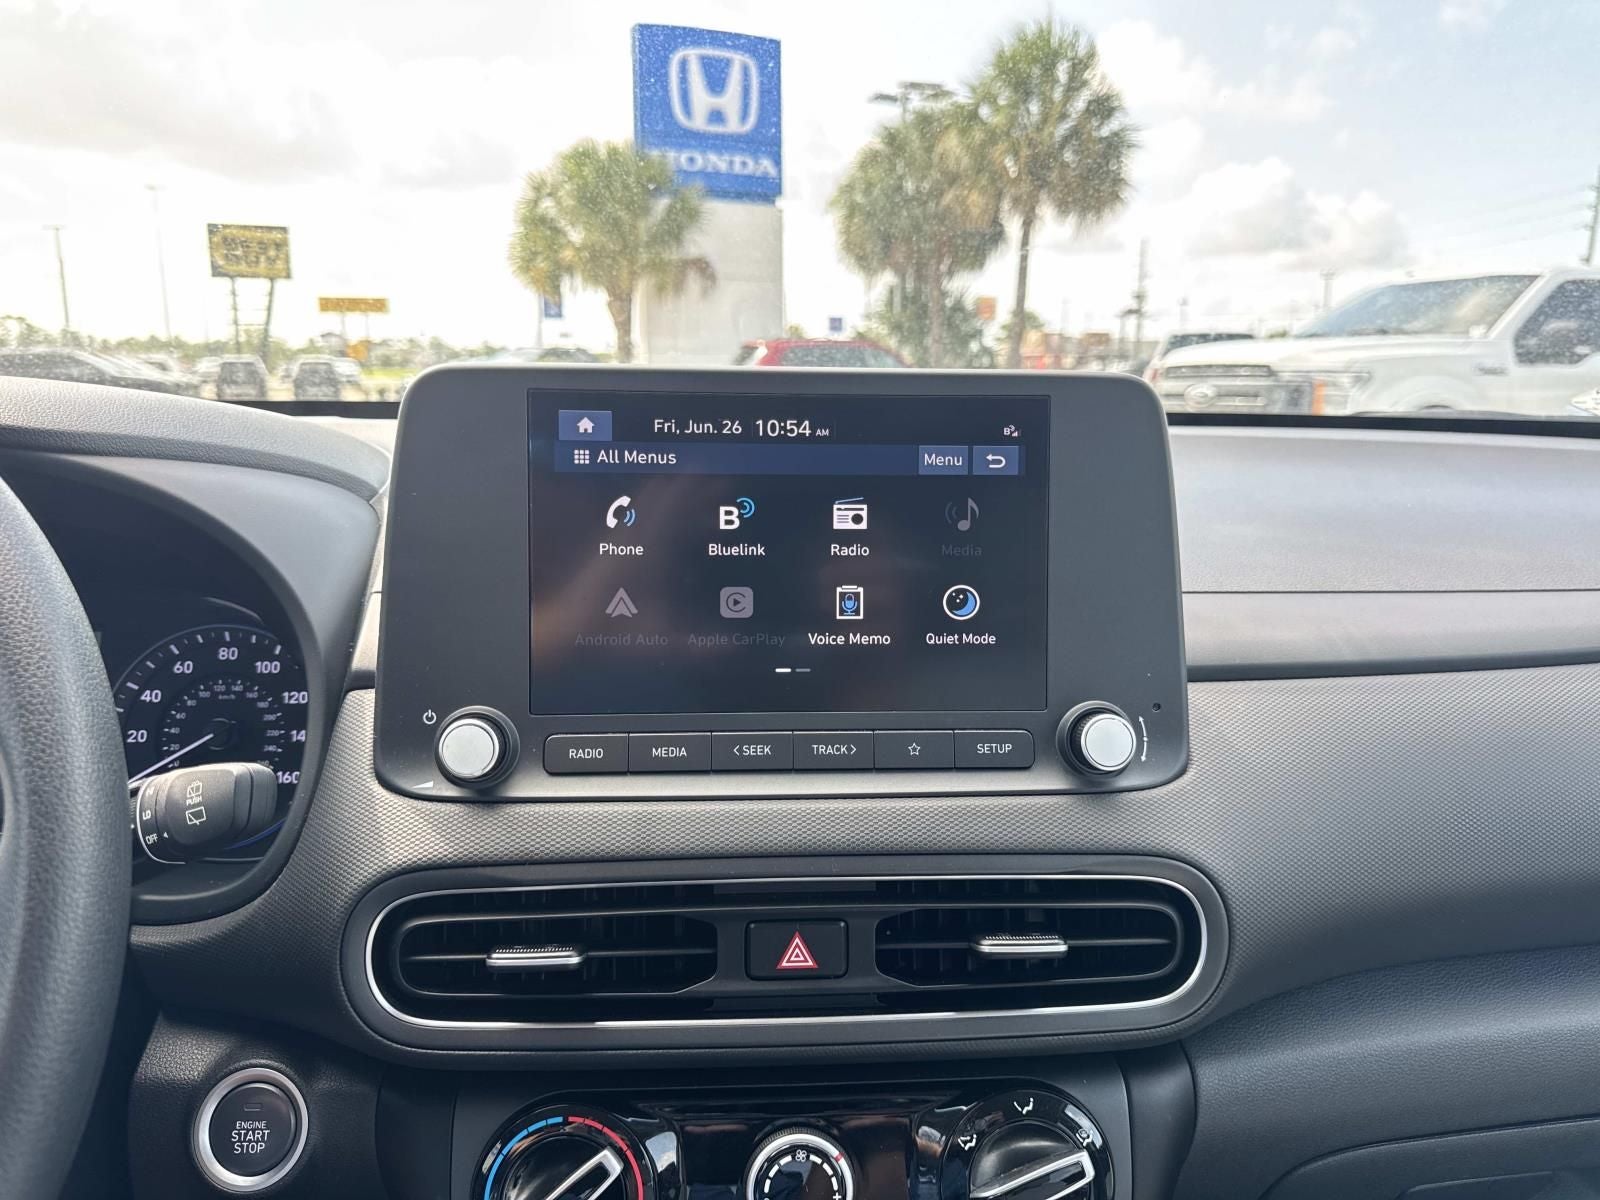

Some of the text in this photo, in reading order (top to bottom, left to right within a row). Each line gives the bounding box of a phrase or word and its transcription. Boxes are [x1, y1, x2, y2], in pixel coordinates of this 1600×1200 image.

[654, 419, 743, 436] Fri, Jun. 26
[755, 419, 830, 437] 10:54 AM
[596, 449, 677, 465] All Menus
[924, 453, 963, 466] Menu
[599, 542, 644, 556] Phone
[708, 543, 766, 556] Bluelink
[830, 543, 870, 556] Radio
[941, 543, 983, 557] Media
[575, 633, 669, 646] Android Auto
[687, 633, 786, 648] Apple CarPlay
[807, 632, 891, 645] Voice Memo
[925, 632, 997, 646] Quiet Mode
[218, 647, 239, 661] 80
[173, 660, 194, 674] 60
[255, 660, 281, 674] 100
[140, 689, 162, 703] 40
[282, 691, 309, 704] 120
[126, 729, 148, 743] 20
[290, 729, 306, 742] 14
[568, 748, 604, 760] RADIO
[652, 746, 687, 758] MEDIA
[742, 744, 772, 756] SEEK
[811, 744, 847, 755] TRACK
[976, 743, 1013, 754] SETUP
[276, 771, 300, 784] 160
[145, 833, 158, 845] OFF
[235, 1120, 268, 1130] ENGINE
[231, 1129, 271, 1142] START
[233, 1142, 266, 1154] STOP
